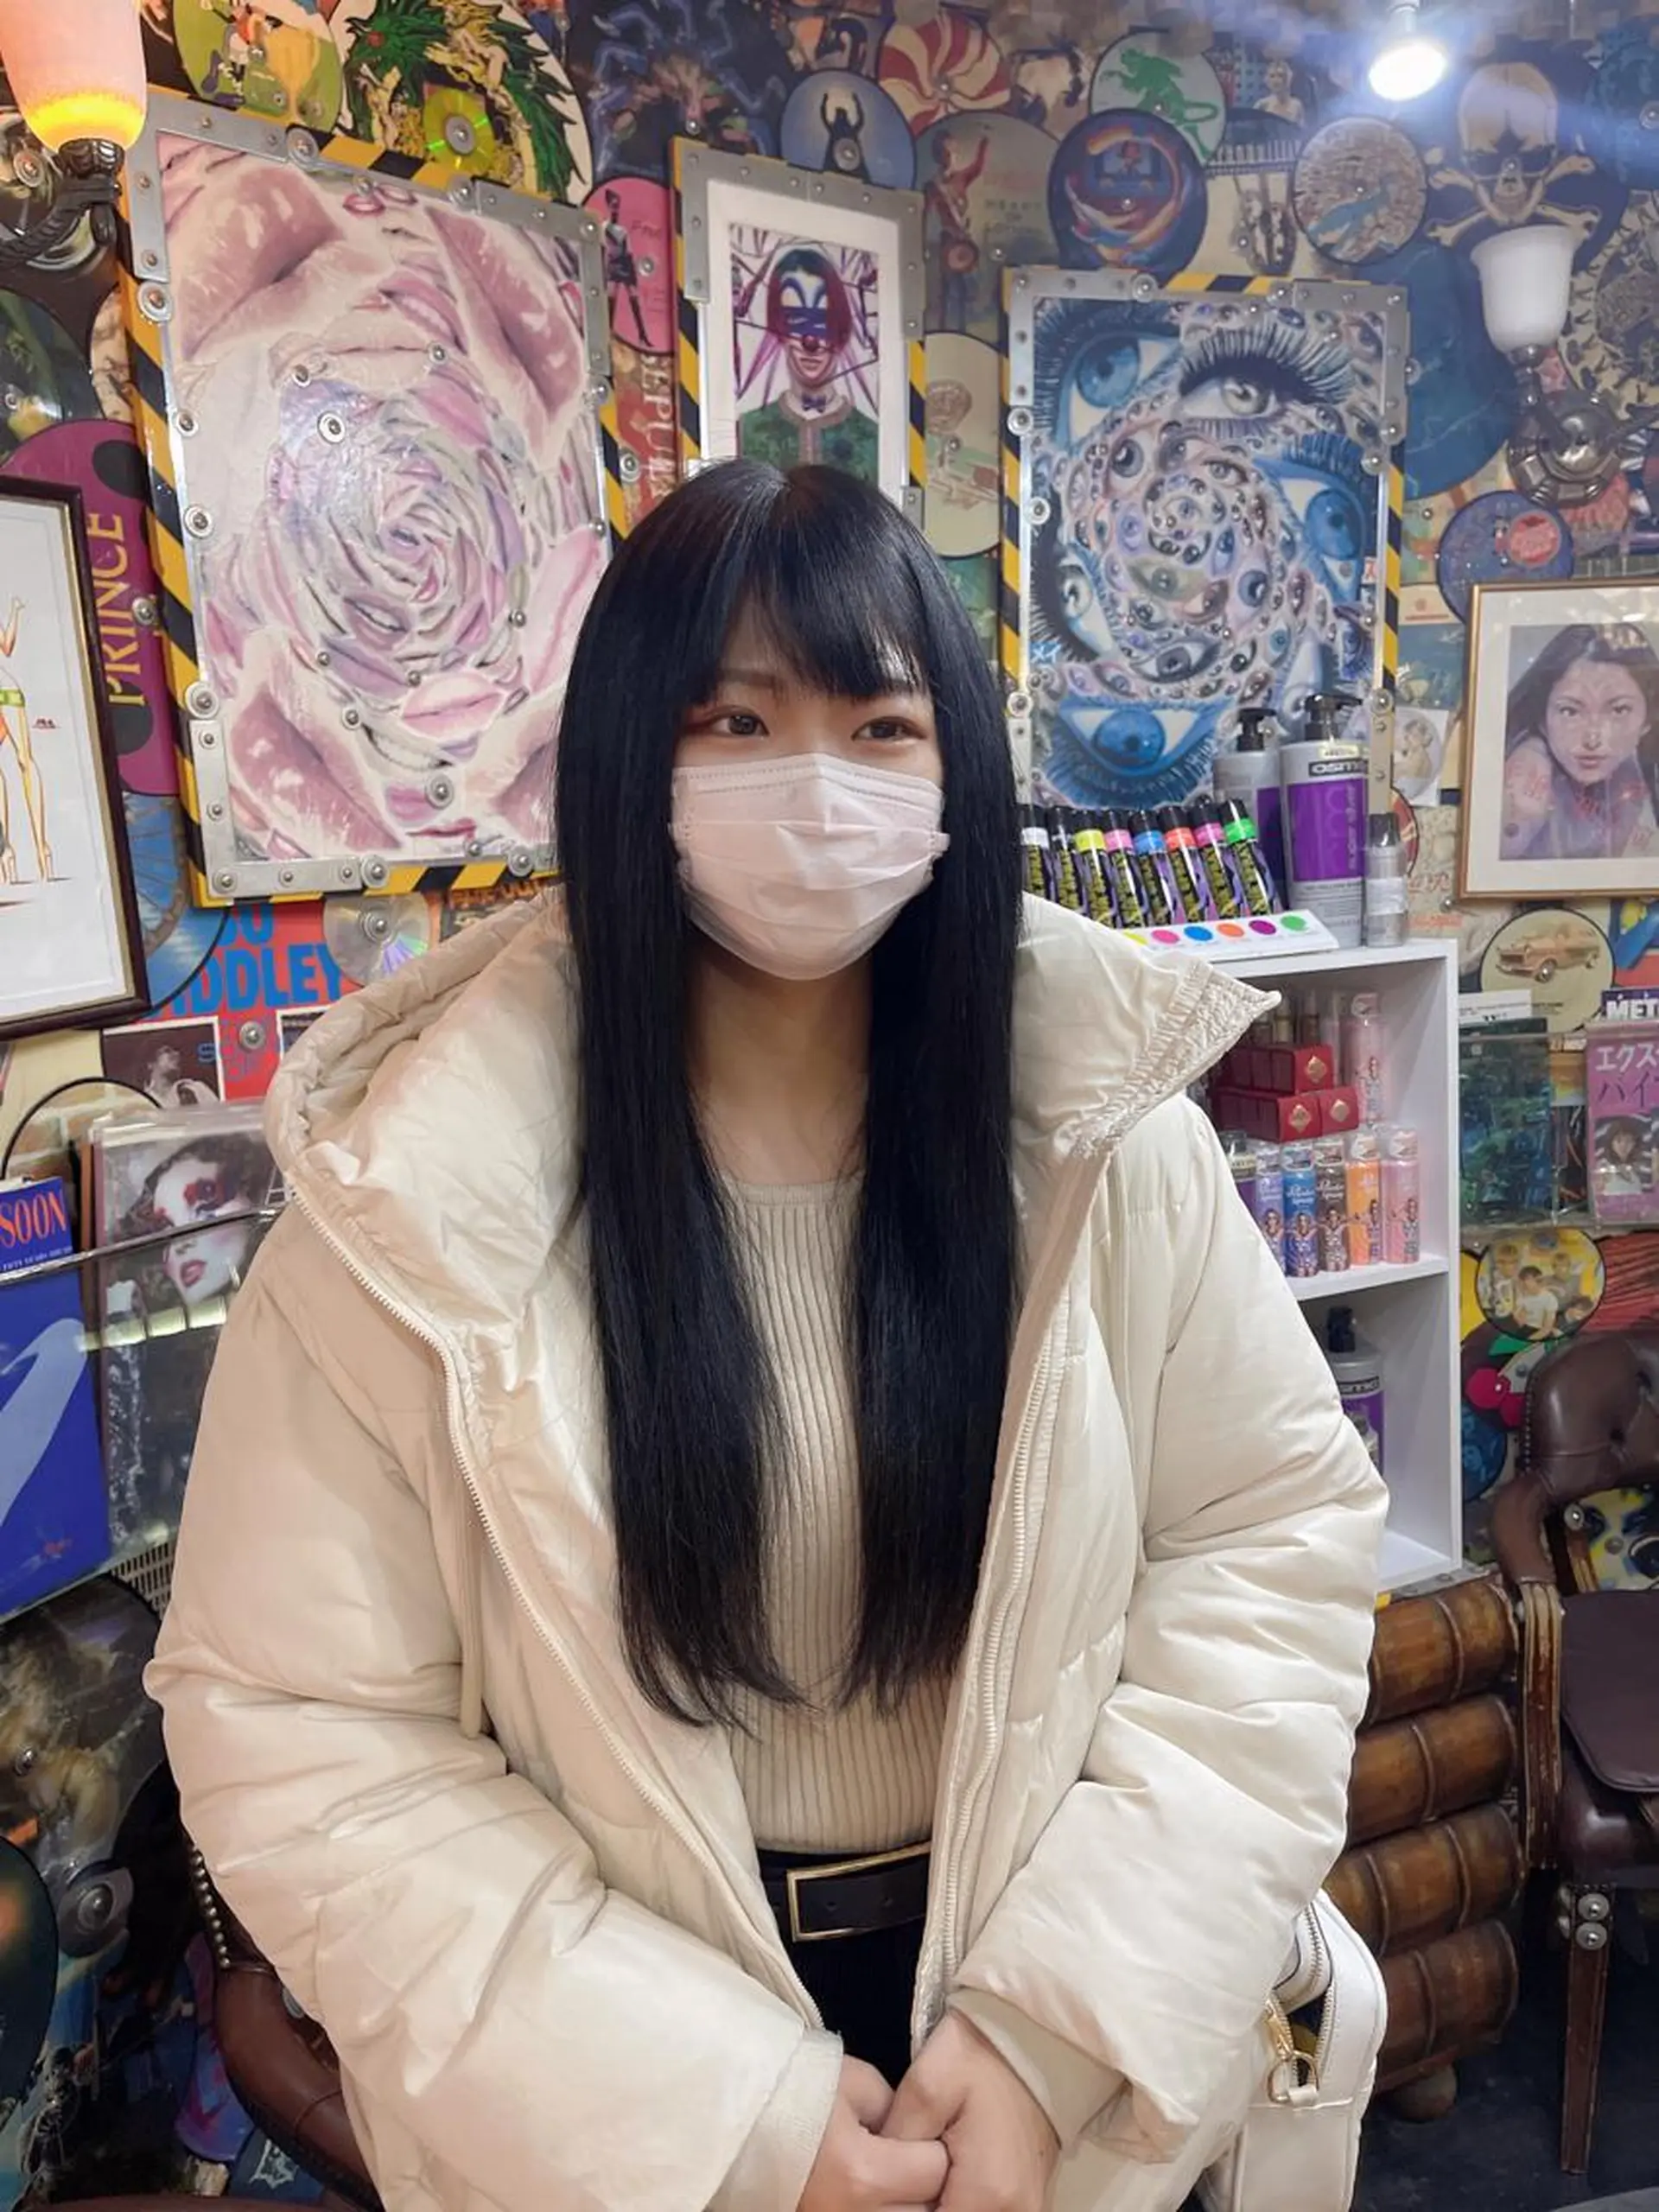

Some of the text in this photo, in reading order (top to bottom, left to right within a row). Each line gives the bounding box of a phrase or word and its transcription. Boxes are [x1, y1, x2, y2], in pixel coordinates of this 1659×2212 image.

[86, 513, 145, 706] PRINCE
[149, 943, 342, 1019] DDLEY
[1594, 1042, 1659, 1074] エクス
